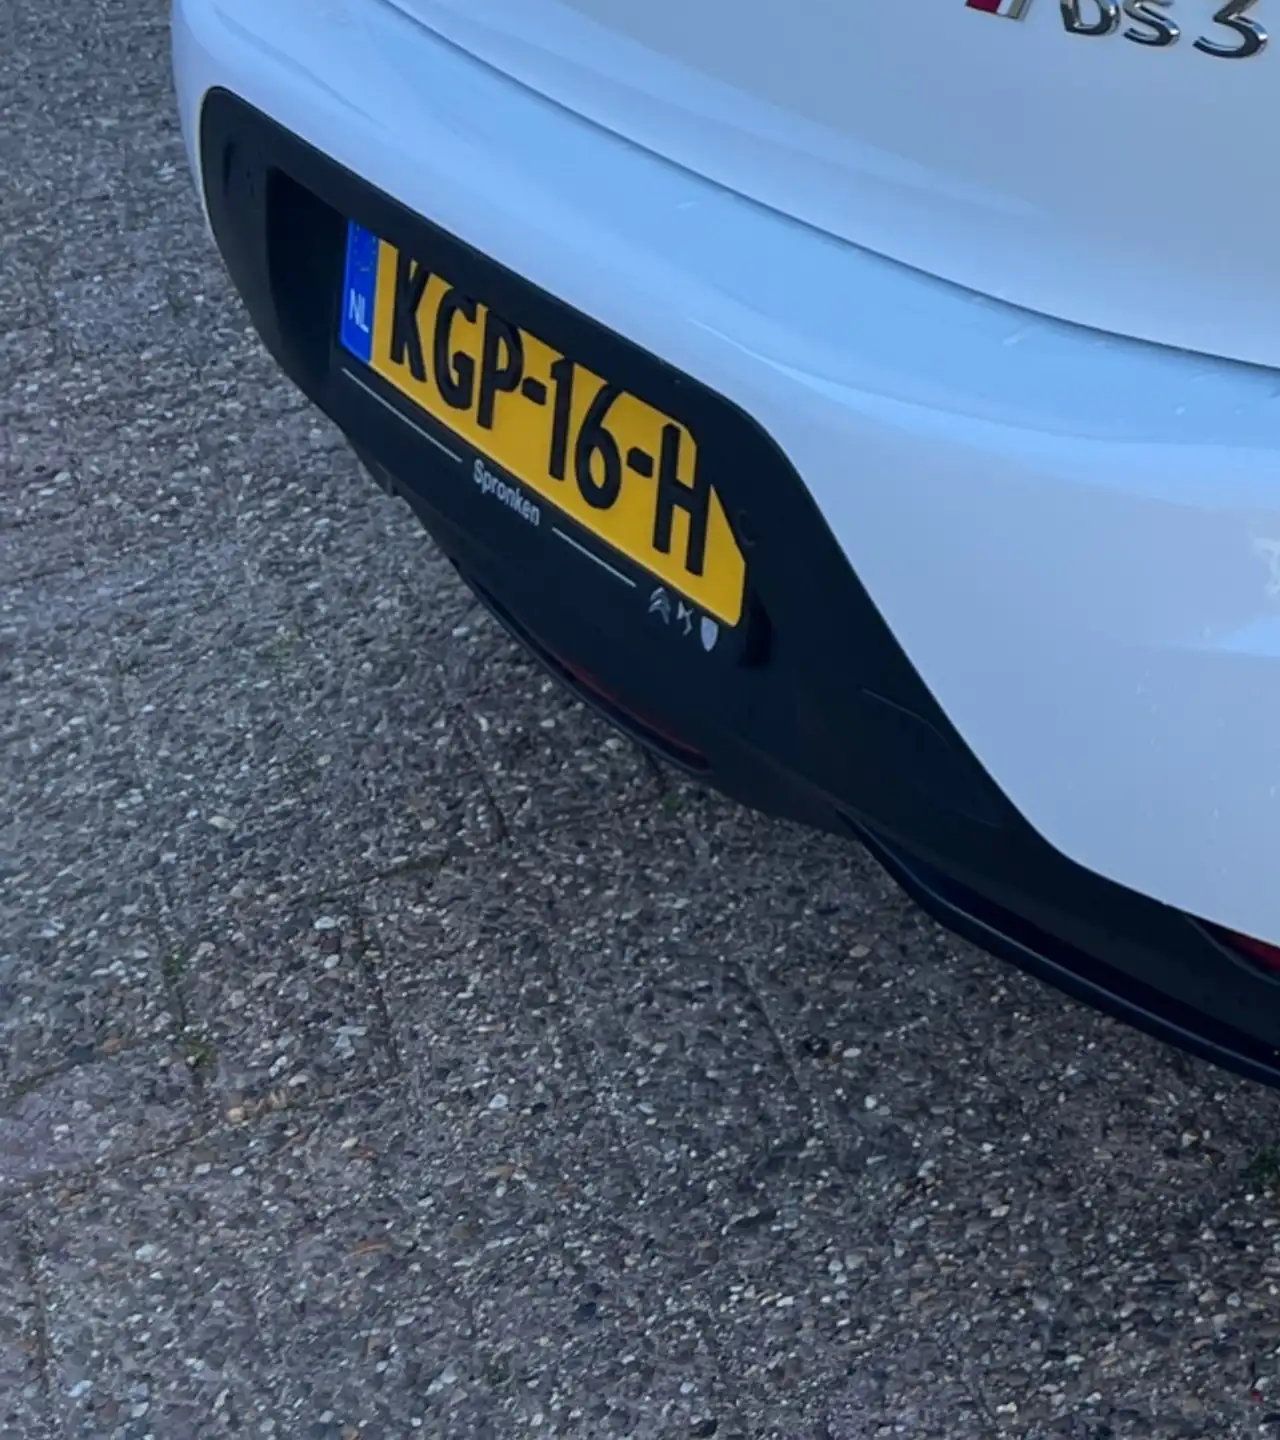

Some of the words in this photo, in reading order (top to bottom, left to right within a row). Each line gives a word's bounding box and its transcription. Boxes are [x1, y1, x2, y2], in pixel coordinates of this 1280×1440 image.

[347, 288, 370, 334] NL
[389, 247, 706, 577] KGP-16-H
[473, 458, 540, 527] Spronken
